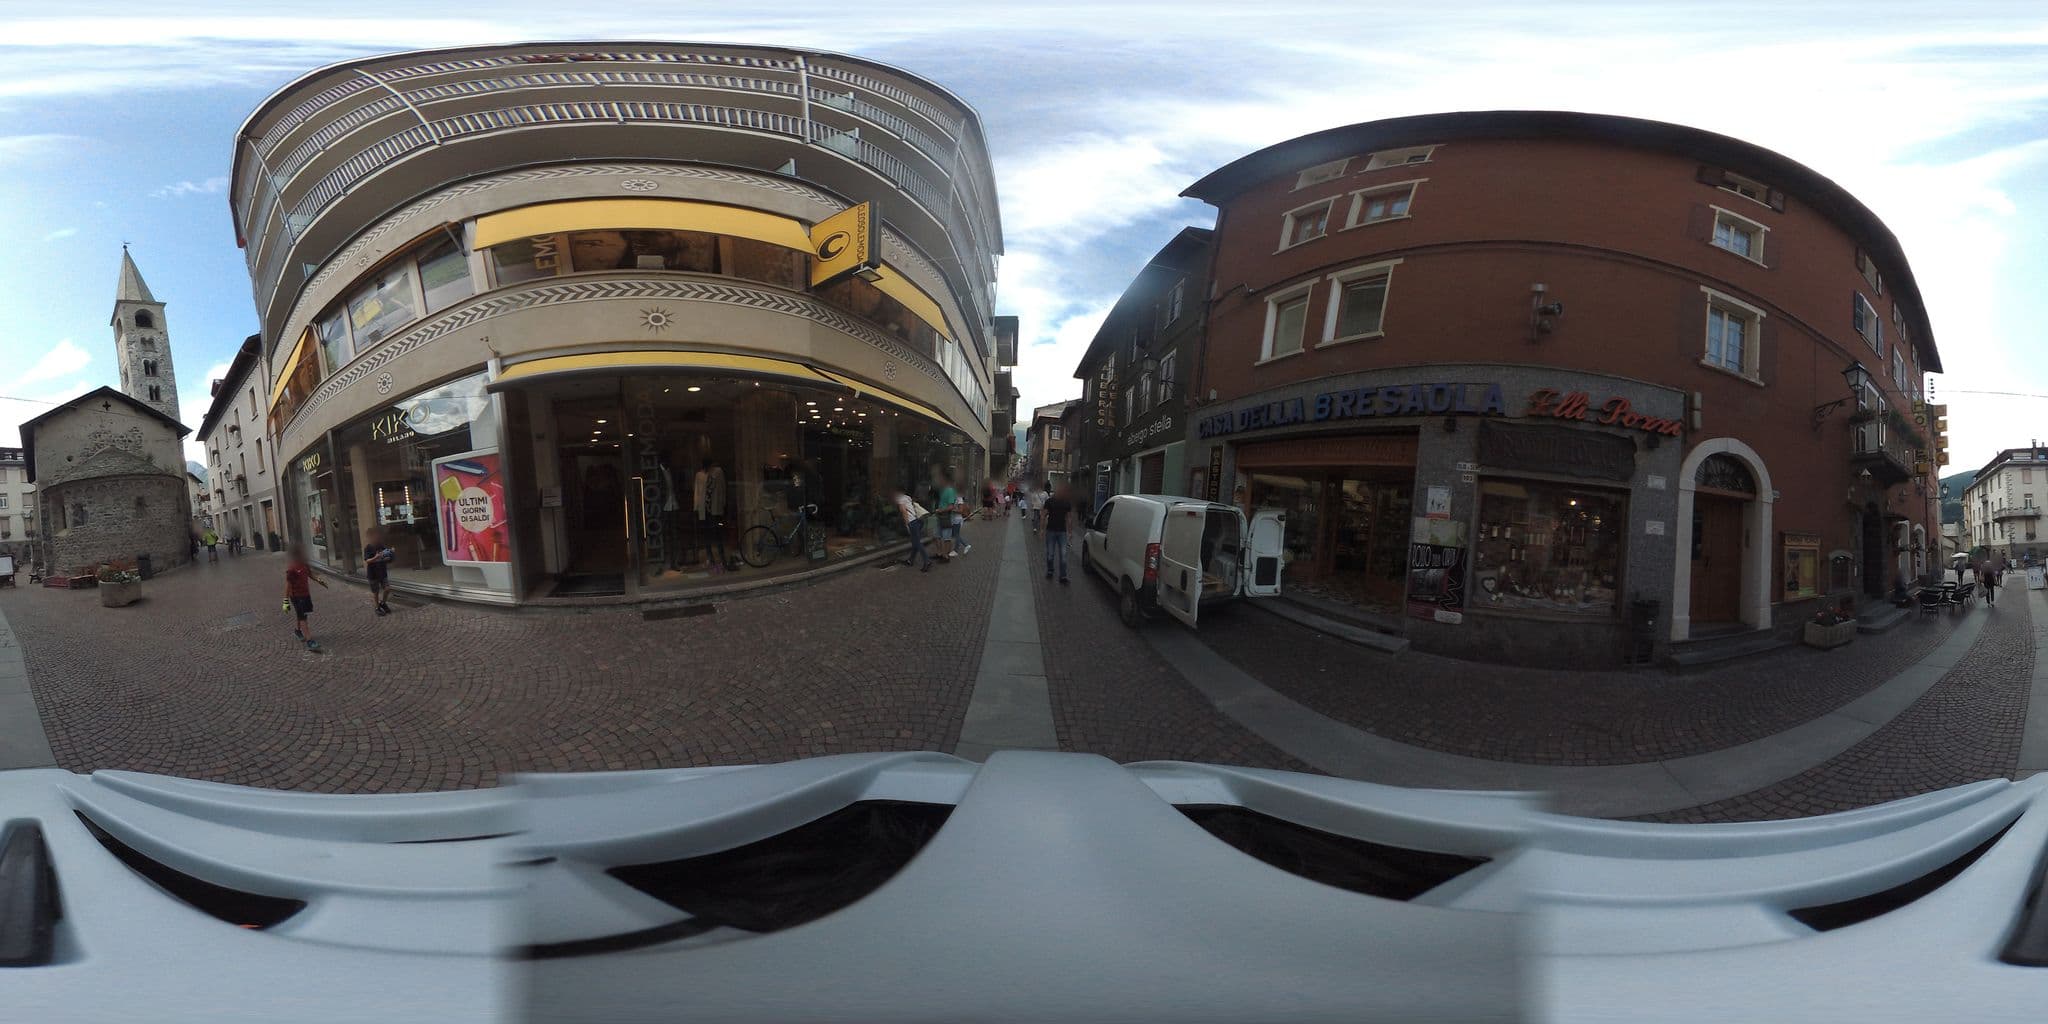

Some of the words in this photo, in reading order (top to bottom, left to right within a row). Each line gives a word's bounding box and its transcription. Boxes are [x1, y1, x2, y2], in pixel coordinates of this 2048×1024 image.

[1199, 412, 1233, 440] CASA
[1240, 397, 1306, 431] DELLA
[1314, 382, 1504, 422] BRESAOLA
[372, 403, 430, 441] KIKO
[1913, 400, 1928, 475] HOEL
[302, 453, 321, 472] KIKO
[459, 496, 488, 507] ULTIMI
[462, 506, 487, 514] GIORNI
[461, 514, 468, 523] DI
[469, 514, 490, 522] SALDI
